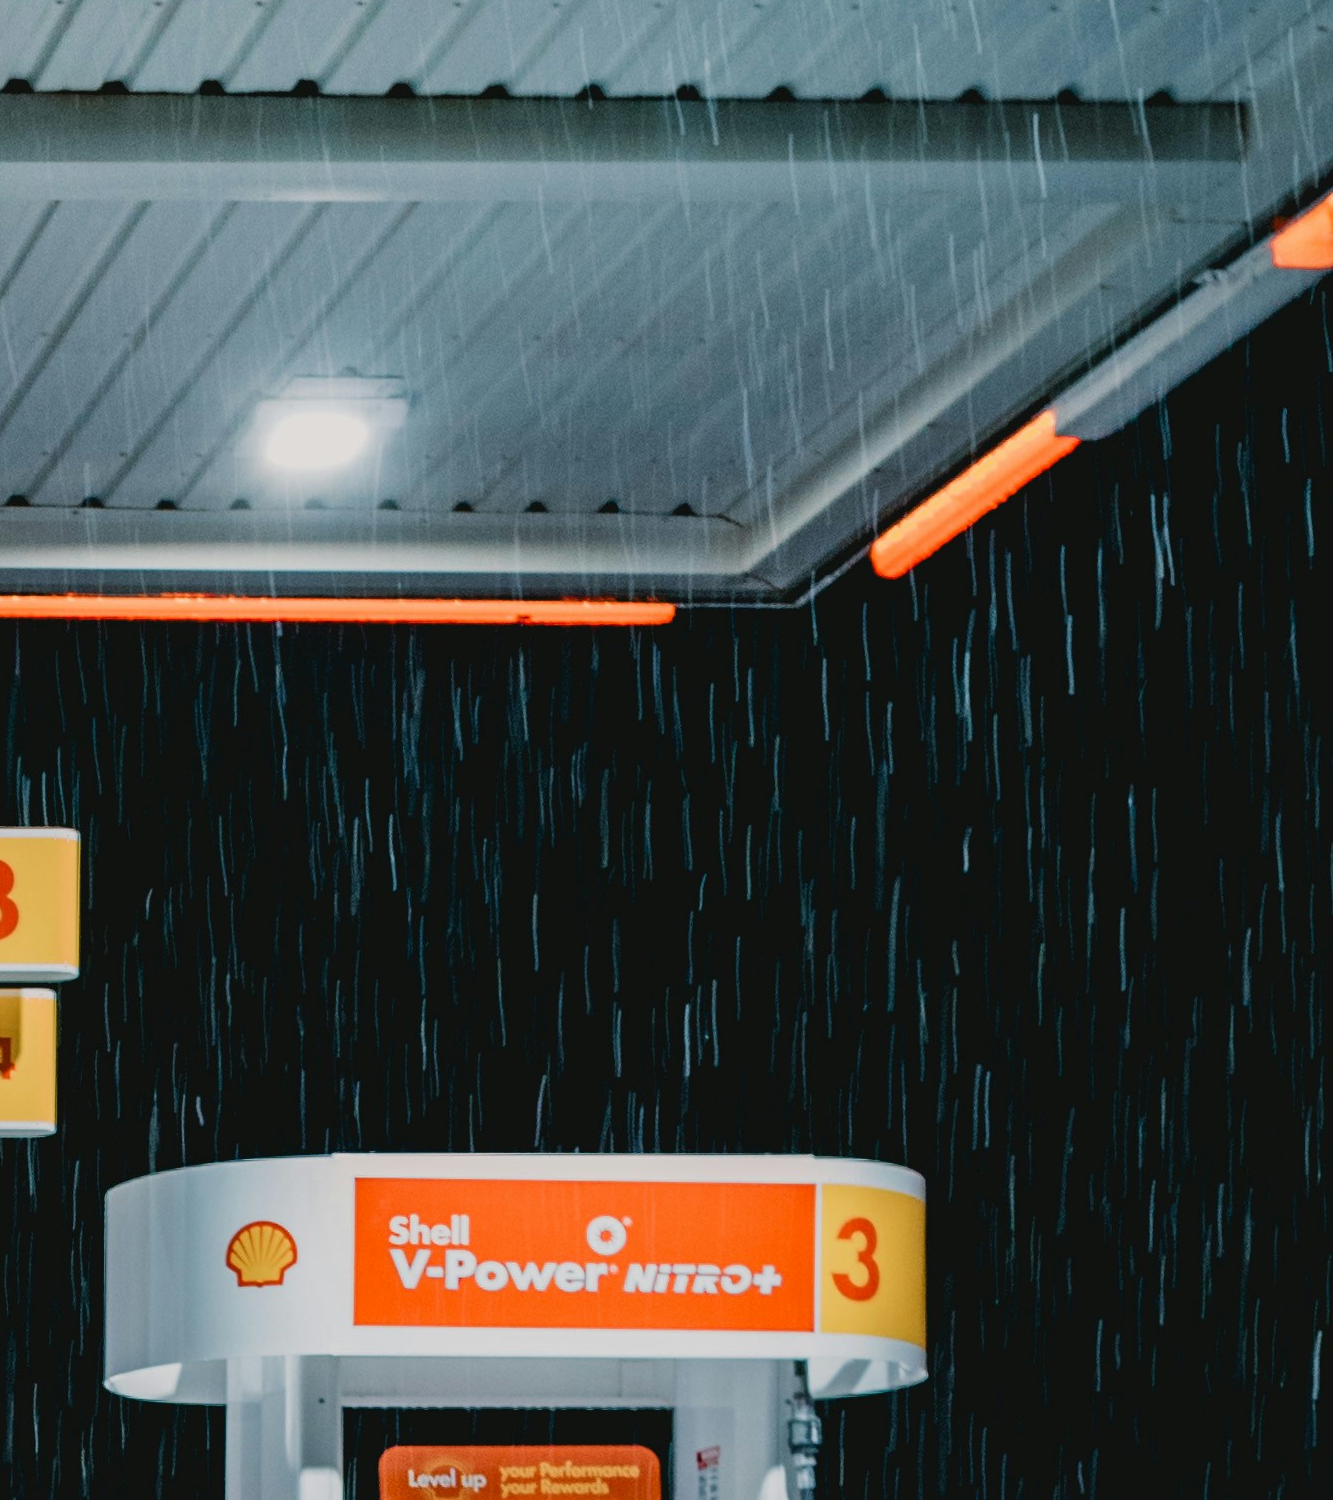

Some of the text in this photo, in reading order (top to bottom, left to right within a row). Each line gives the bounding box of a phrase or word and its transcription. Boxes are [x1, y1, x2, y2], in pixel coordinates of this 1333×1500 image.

[388, 1213, 470, 1246] Shell
[388, 1248, 609, 1293] V-Power
[831, 1217, 880, 1302] 3
[407, 1467, 487, 1492] Level up
[499, 1460, 640, 1482] your Performance
[500, 1479, 610, 1498] your Rewards
